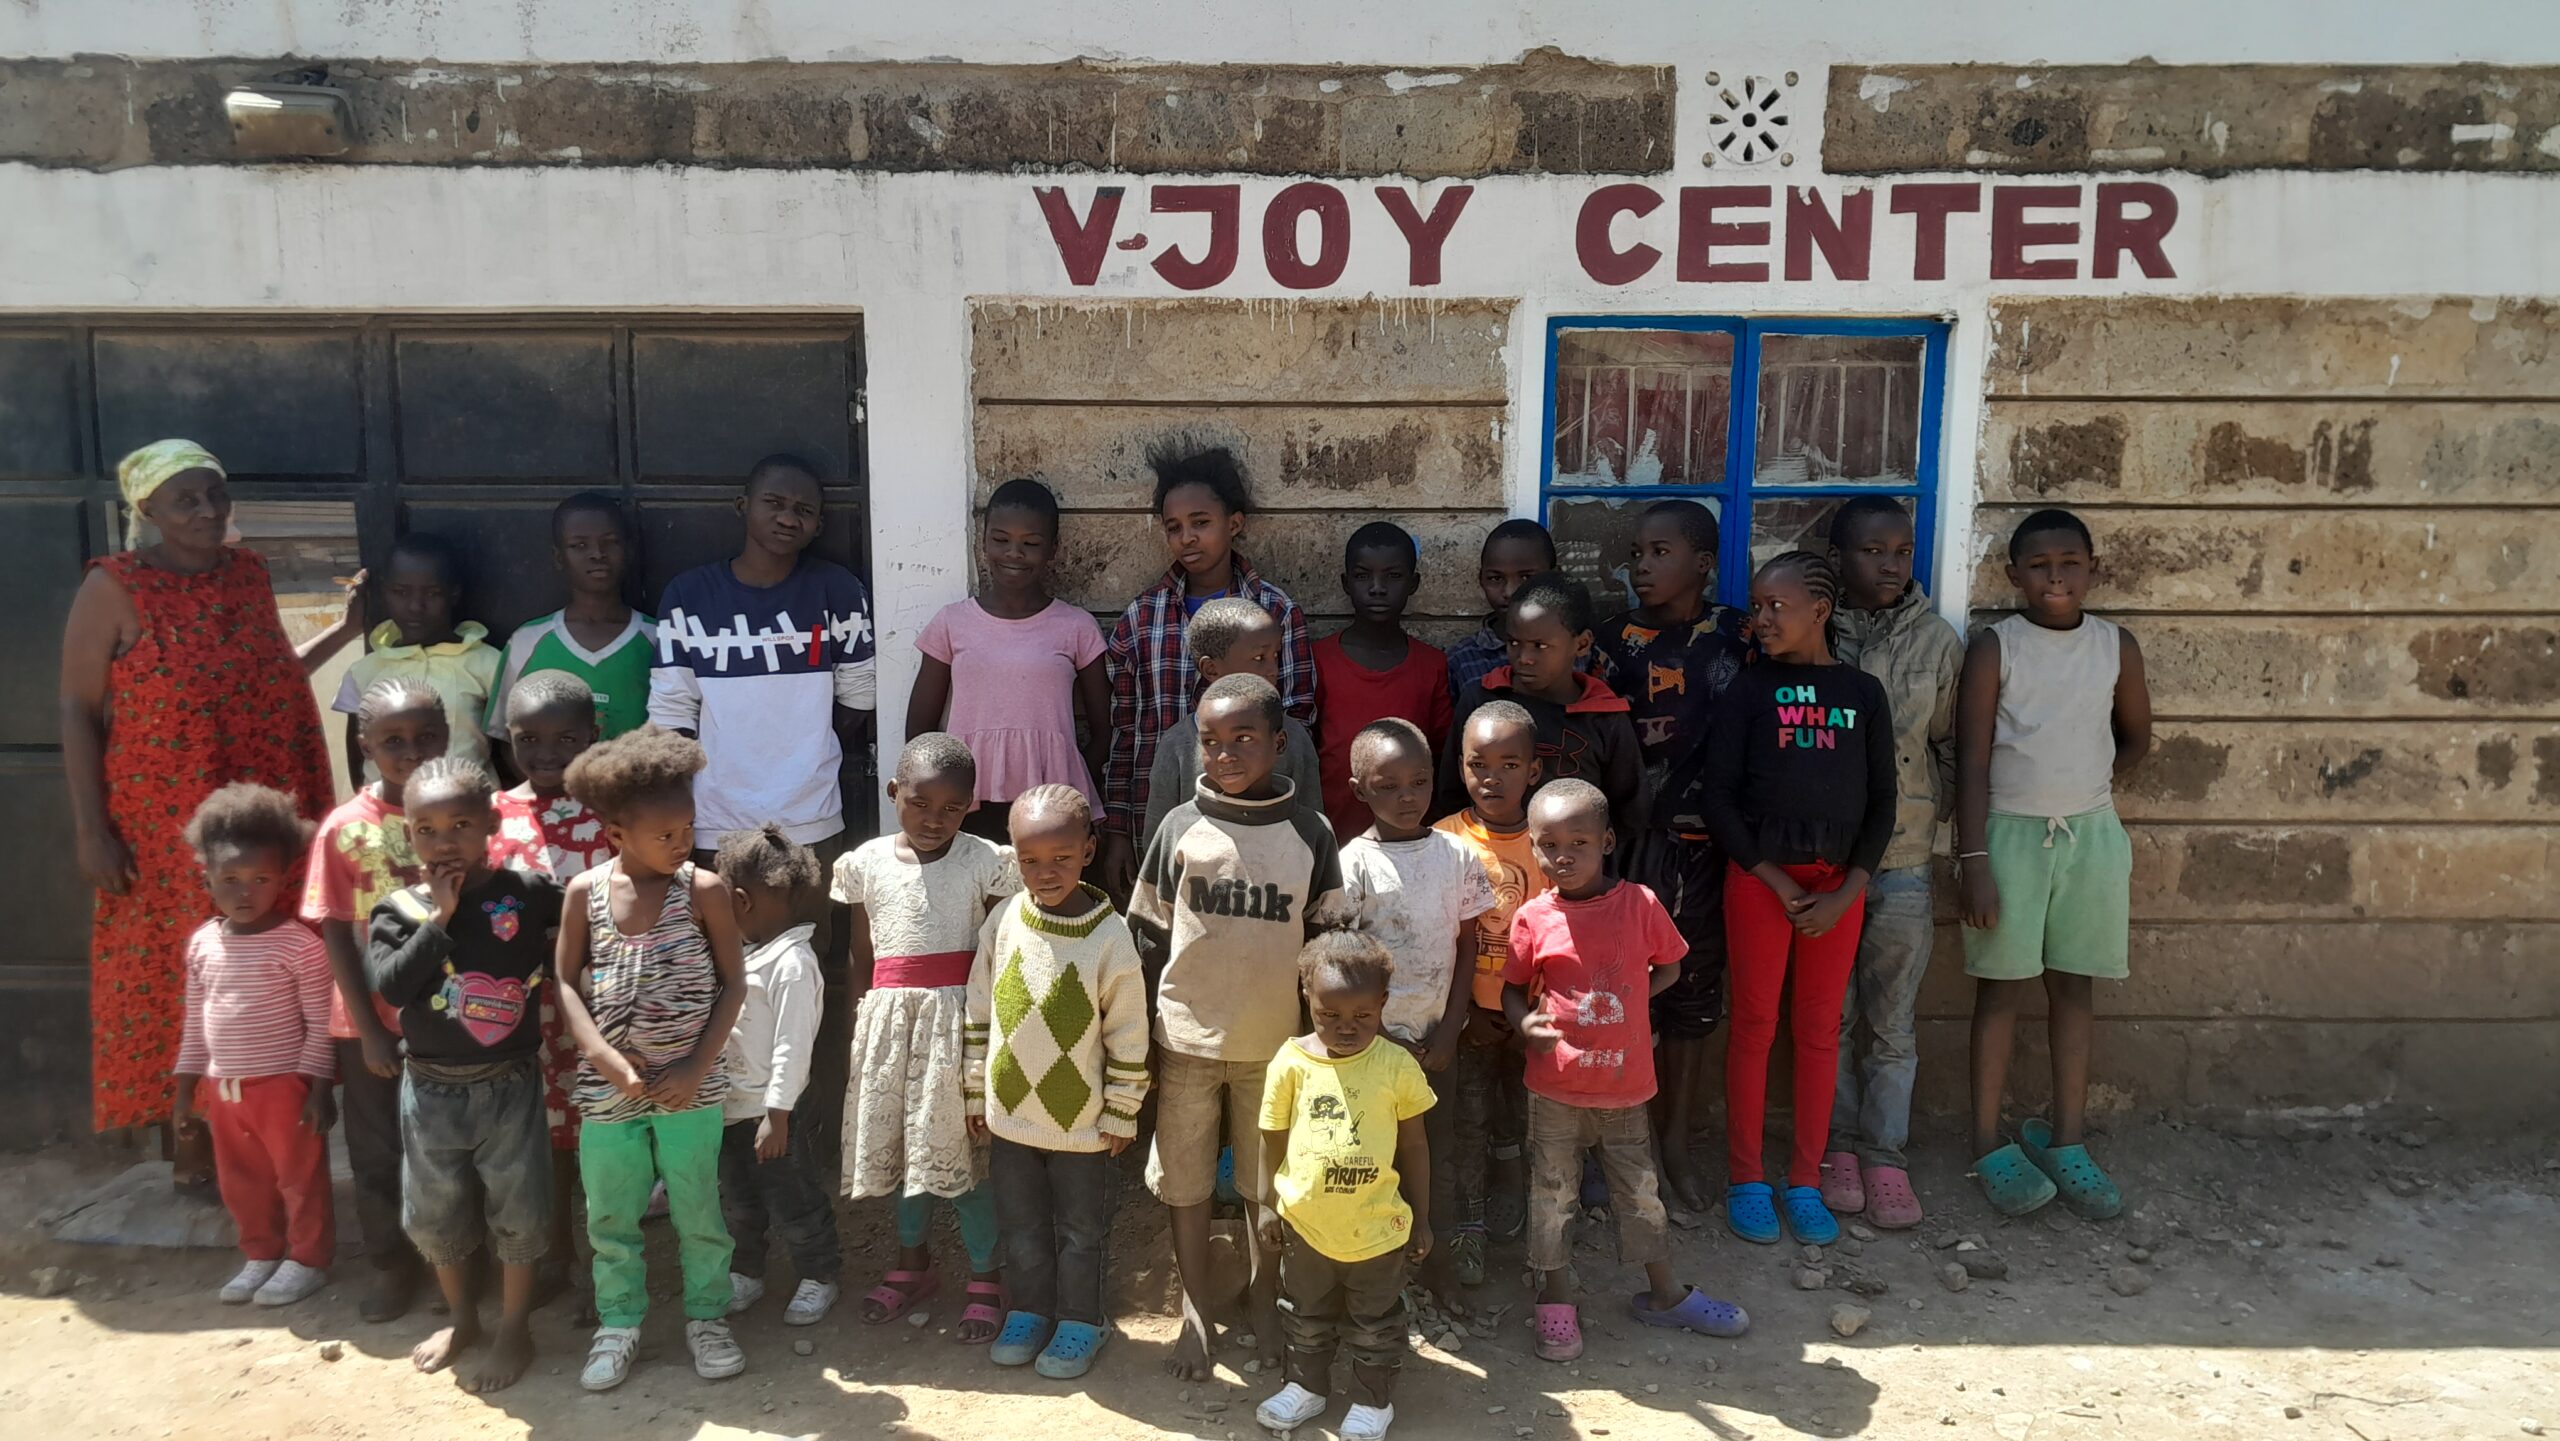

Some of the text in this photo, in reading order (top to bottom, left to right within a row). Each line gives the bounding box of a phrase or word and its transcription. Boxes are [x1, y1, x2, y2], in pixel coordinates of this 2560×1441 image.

[1575, 182, 2179, 286] CENTER
[1775, 685, 1816, 703] OH
[1777, 705, 1857, 729] WHAT
[1779, 728, 1835, 749] FUN
[1188, 875, 1293, 923] Milk
[1344, 1156, 1374, 1166] CAREFUL
[1324, 1166, 1379, 1186] PIRATES
